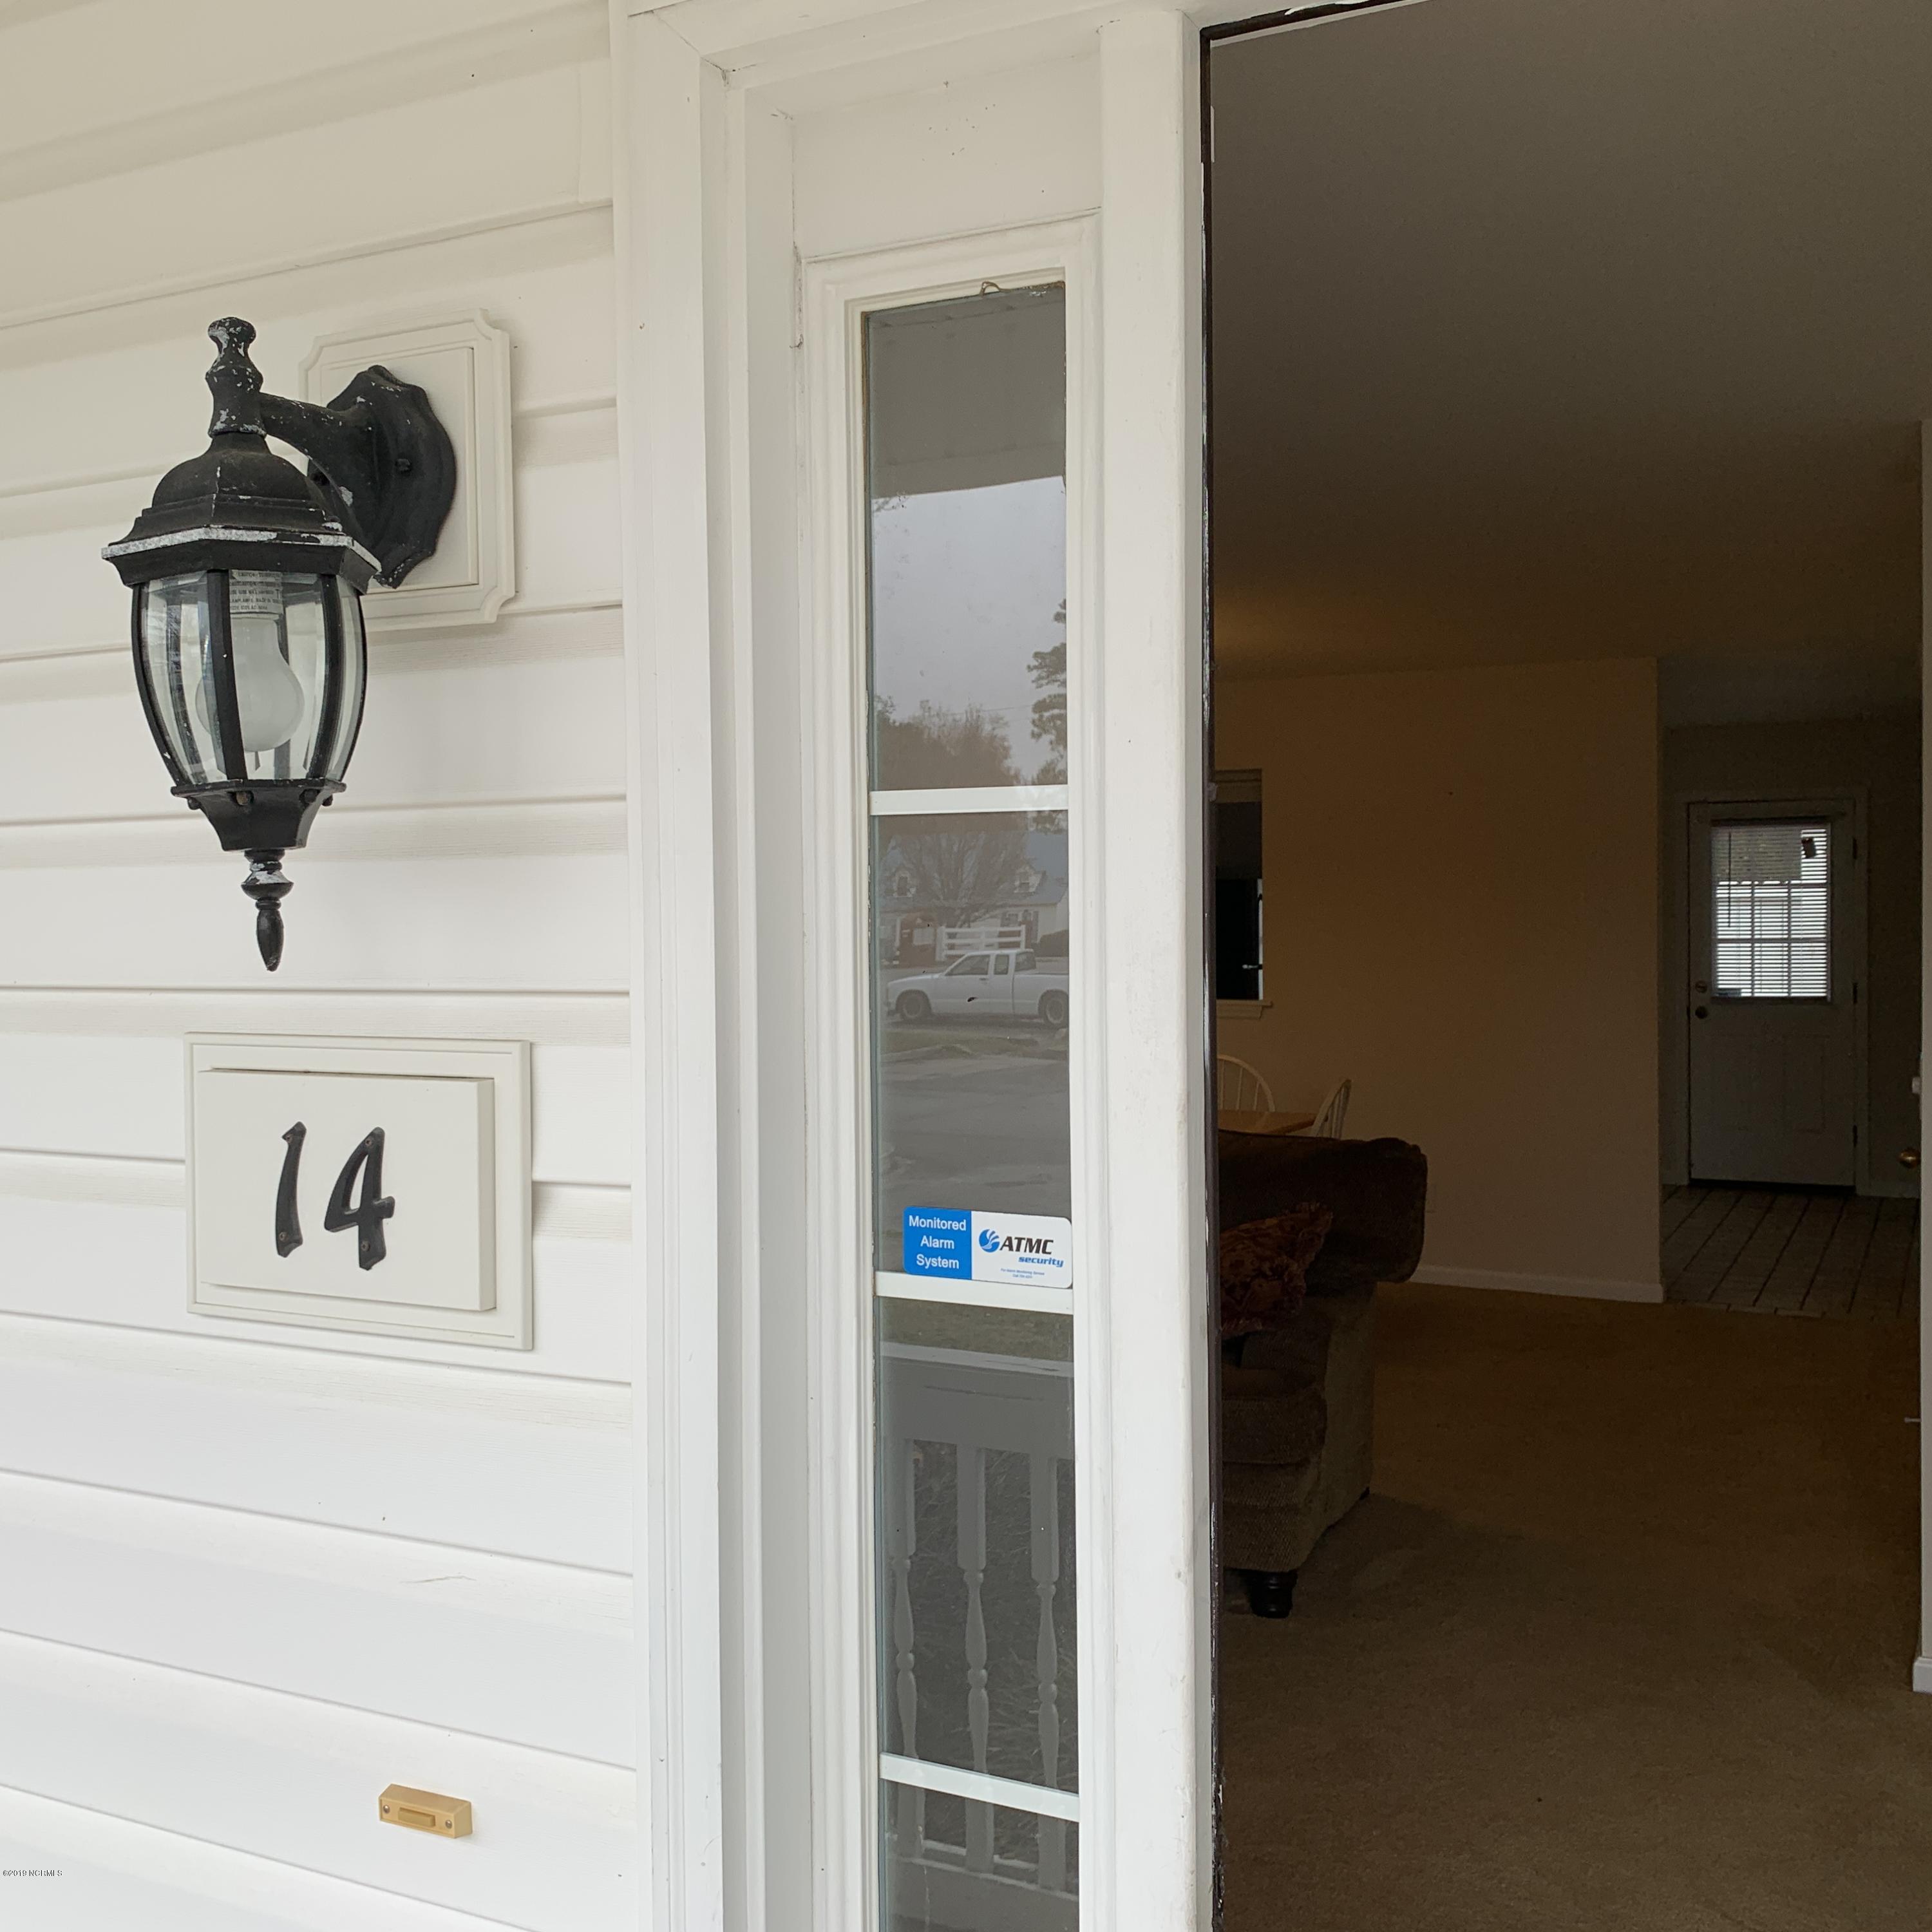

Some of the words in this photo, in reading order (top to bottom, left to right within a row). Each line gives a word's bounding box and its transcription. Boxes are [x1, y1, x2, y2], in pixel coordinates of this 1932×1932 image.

[275, 1121, 395, 1271] 14
[909, 1215, 967, 1231] Monitored
[920, 1235, 954, 1249] Alarm
[999, 1236, 1054, 1255] ATMC
[916, 1254, 960, 1269] System
[1018, 1256, 1064, 1268] security
